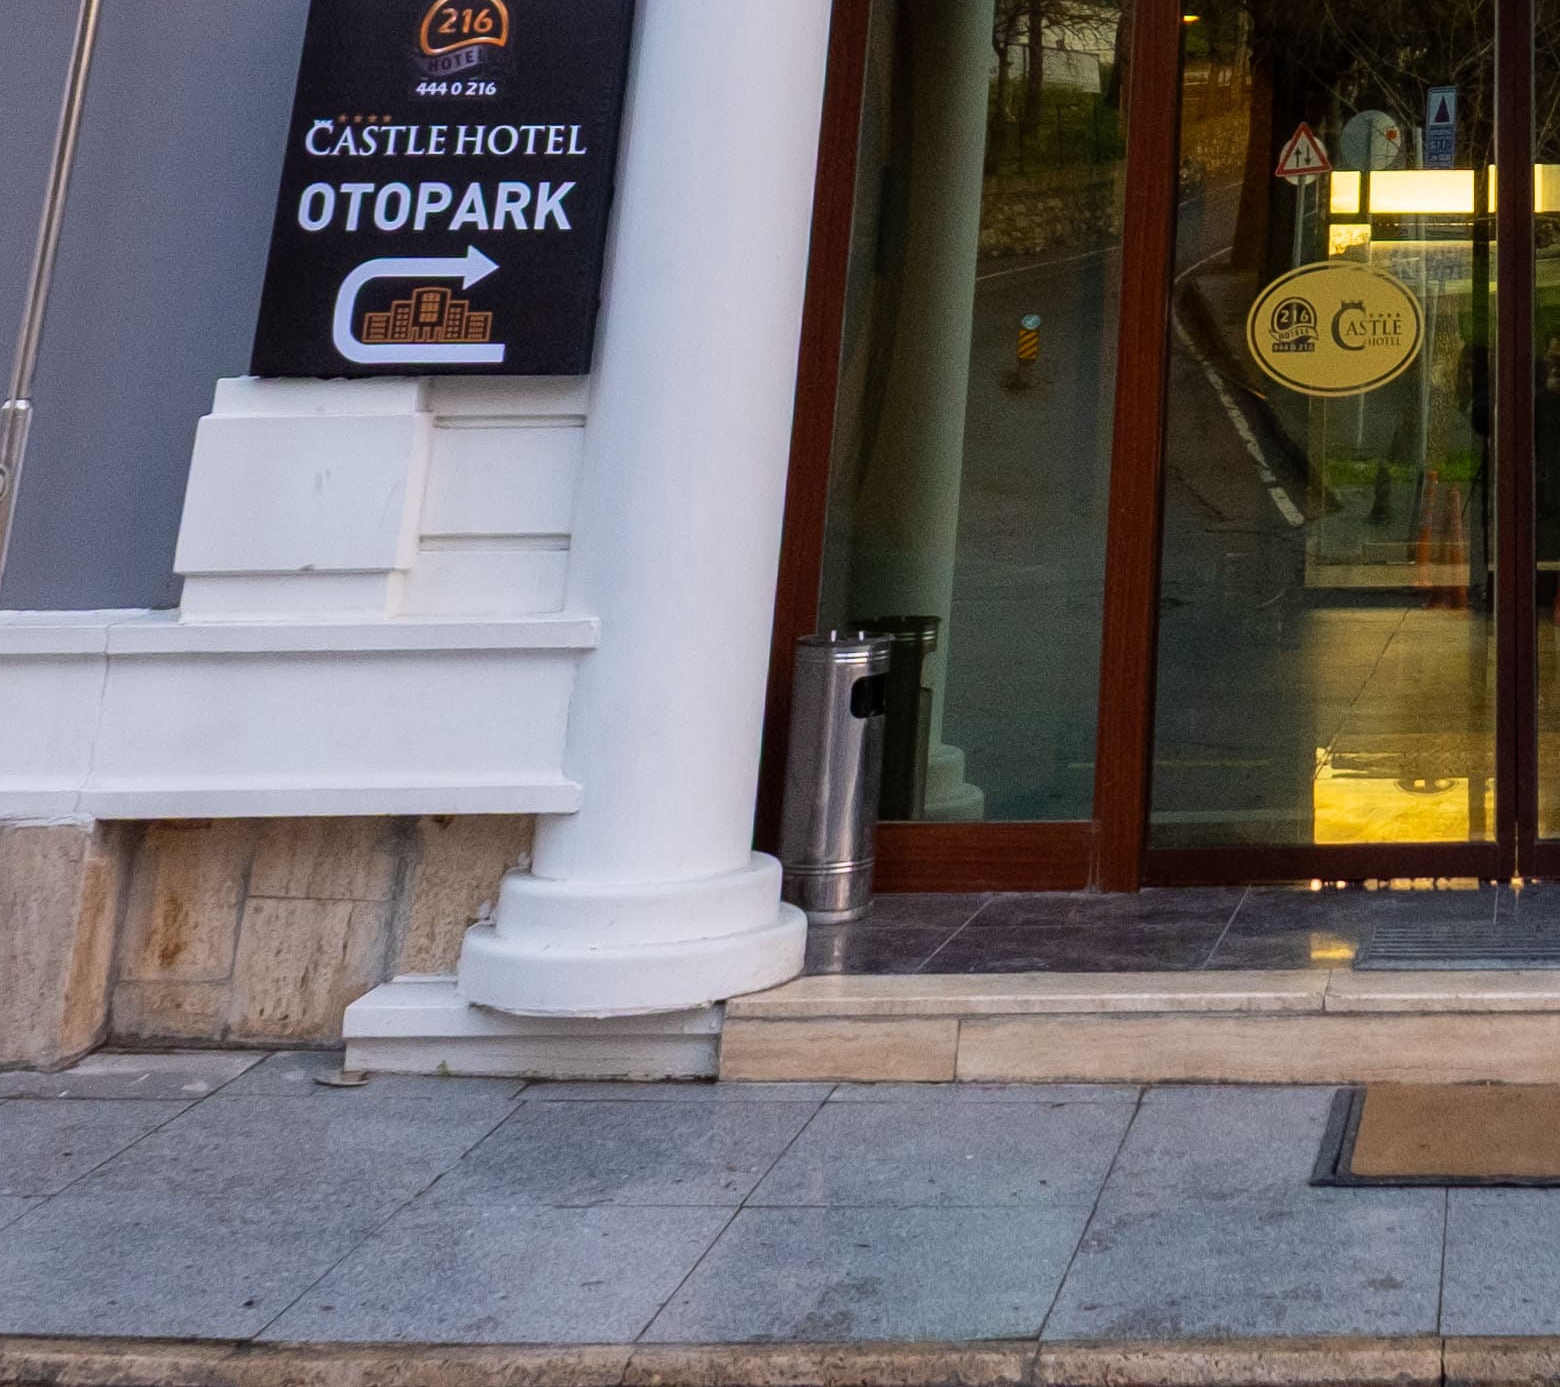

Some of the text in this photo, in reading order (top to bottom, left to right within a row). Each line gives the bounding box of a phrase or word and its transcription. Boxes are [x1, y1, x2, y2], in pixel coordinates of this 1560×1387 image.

[438, 7, 494, 34] 216
[416, 82, 497, 96] 444 0 216
[305, 119, 587, 156] CASTLE HOTEL
[297, 180, 577, 231] OTOPARK
[1280, 307, 1309, 323] 216
